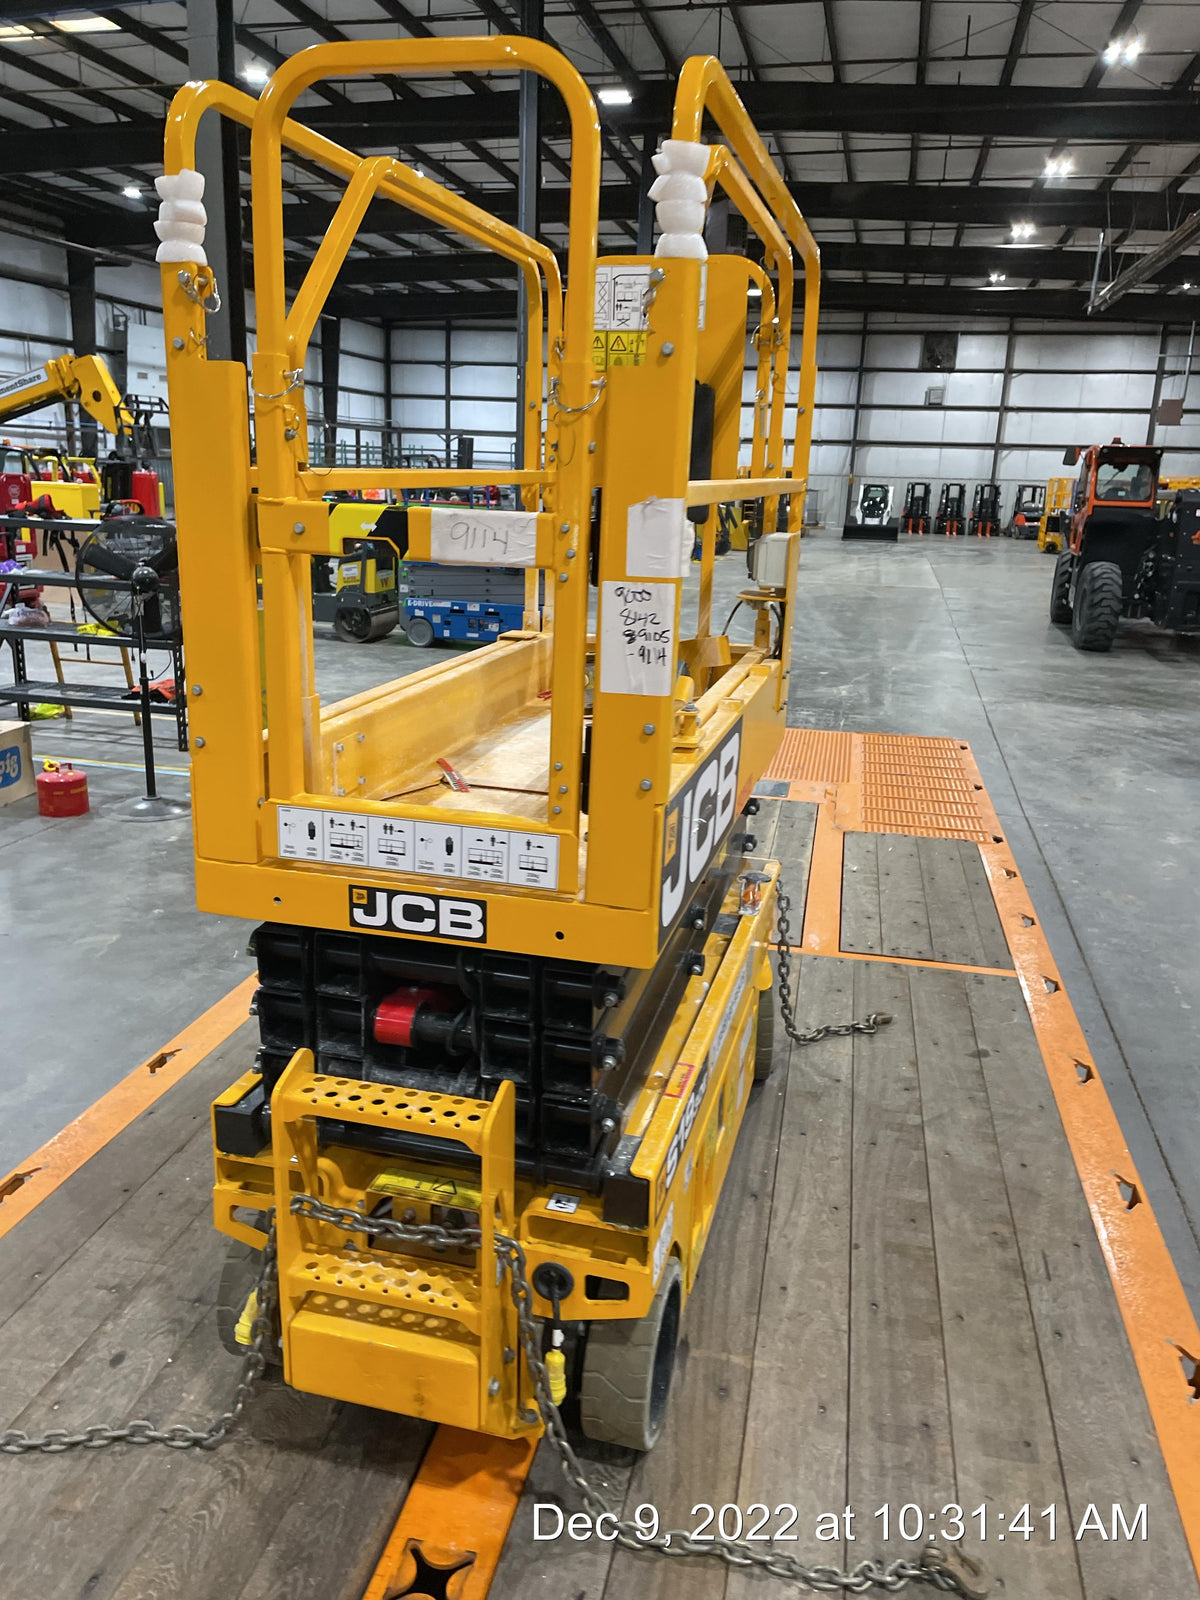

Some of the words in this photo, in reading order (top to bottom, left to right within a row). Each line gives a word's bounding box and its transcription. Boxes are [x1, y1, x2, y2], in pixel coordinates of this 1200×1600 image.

[450, 521, 509, 555] 9114
[661, 732, 739, 927] JCB
[352, 891, 484, 939] JCB
